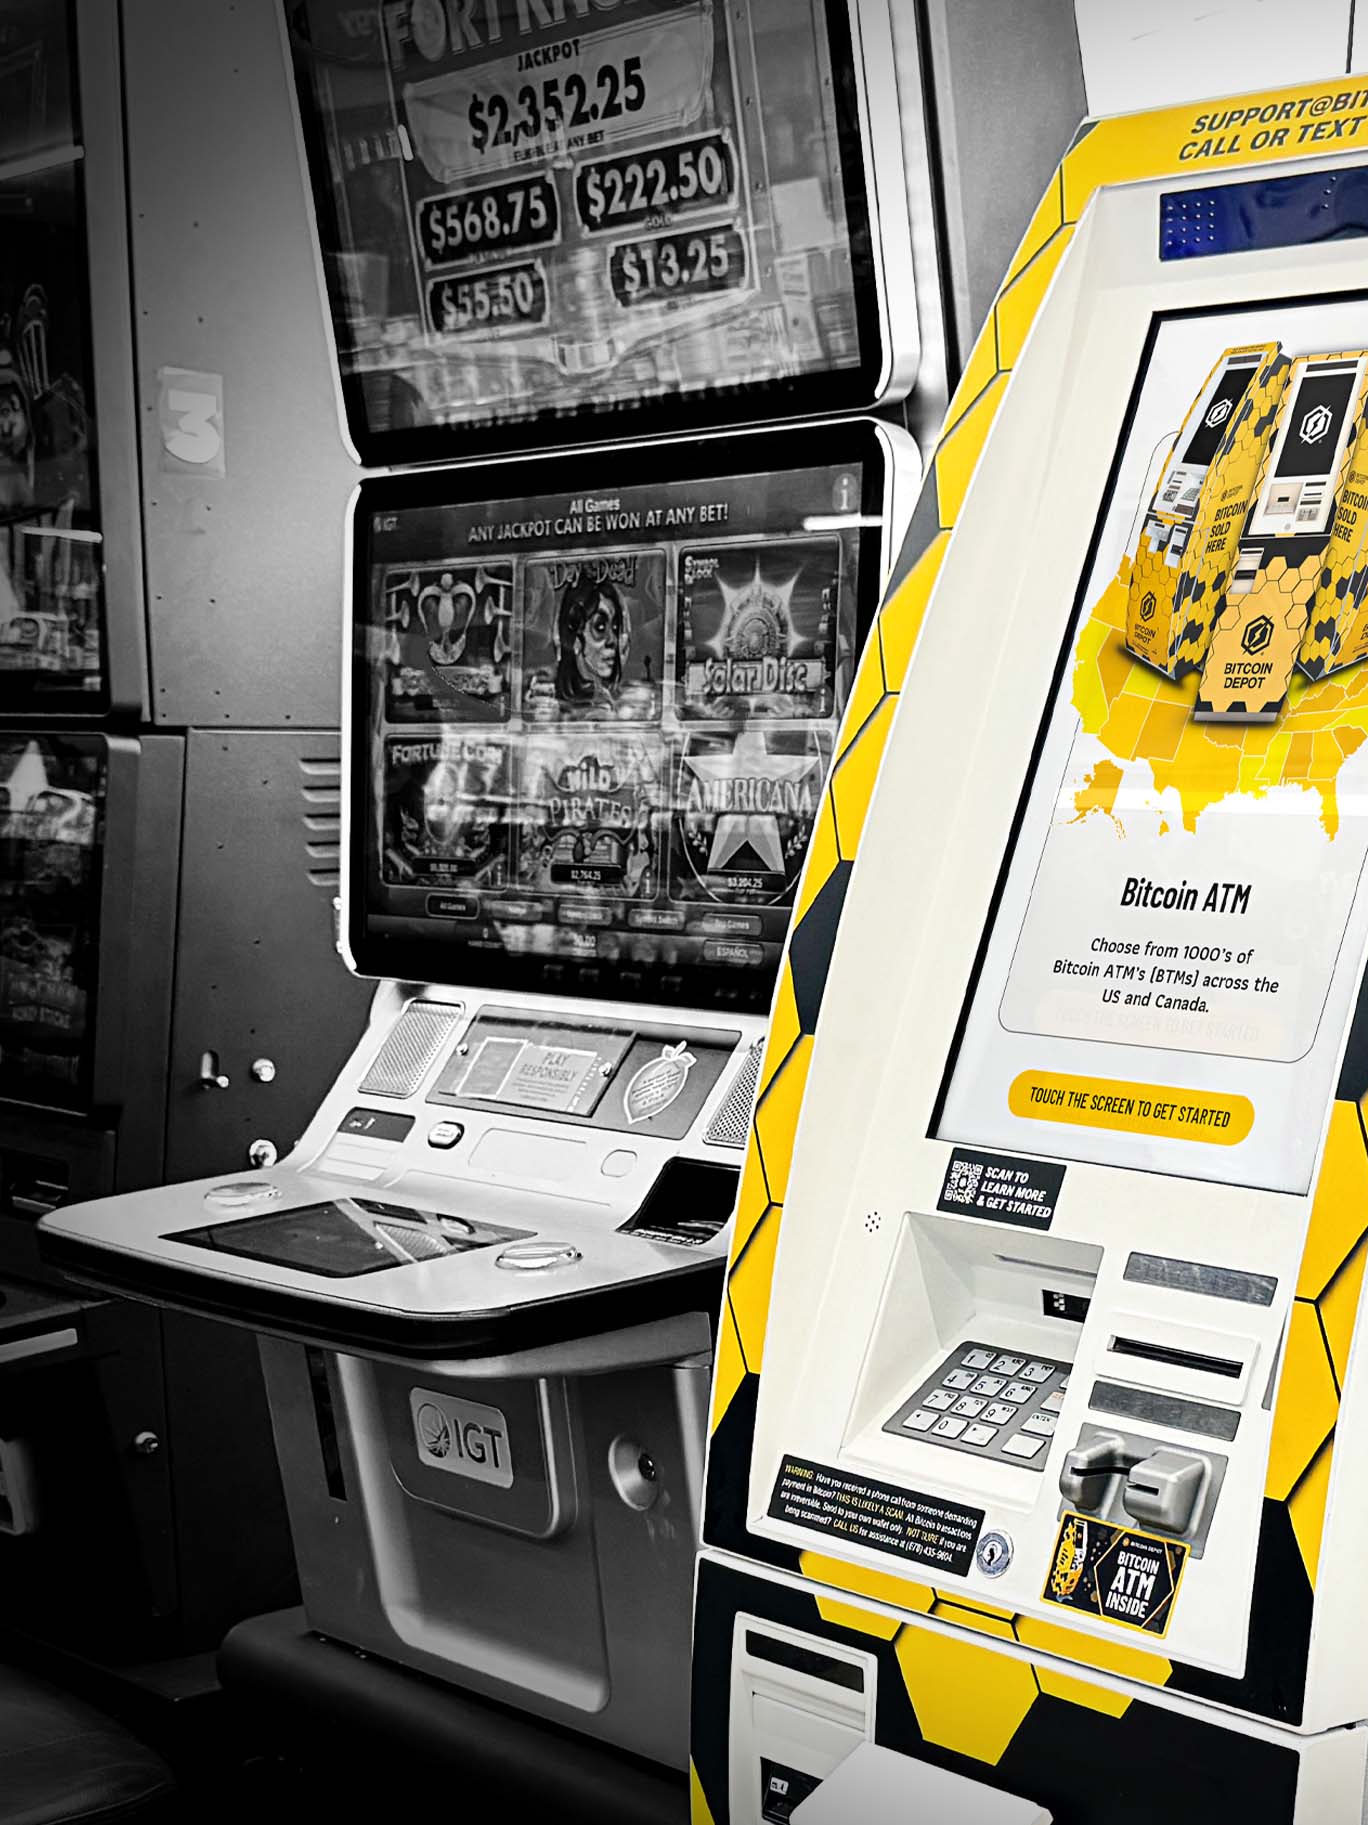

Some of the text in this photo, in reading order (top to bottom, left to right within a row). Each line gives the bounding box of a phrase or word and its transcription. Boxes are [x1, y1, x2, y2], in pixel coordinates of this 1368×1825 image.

[517, 39, 580, 72] JACKPOT
[469, 56, 645, 154] $2,352.25
[1178, 130, 1246, 163] CALL
[1249, 124, 1294, 152] OR
[1296, 117, 1367, 145] TEXT
[586, 145, 722, 222] $222.50
[429, 186, 547, 255] $568.75
[622, 234, 729, 301] $13.25
[441, 271, 533, 332] $55.50
[570, 499, 584, 514] All
[1214, 500, 1248, 521] BITCOIN
[1338, 506, 1357, 525] SOLD
[468, 504, 728, 544] ANY JACKPOT CAN BE WON AT ANY BET!
[1210, 522, 1230, 538] SOLD
[1334, 522, 1353, 543] HERE
[1205, 538, 1227, 553] HERE
[703, 657, 808, 695] Solar Disc
[1224, 662, 1273, 674] BITCOIN
[1224, 677, 1266, 689] DEPOT
[687, 778, 812, 815] AMERICANA
[1120, 877, 1252, 914] Bitcoin ATM
[1090, 937, 1254, 964] Choose from 1000's of
[1053, 960, 1100, 978] Bitcoin
[1104, 963, 1146, 983] ATM's
[1202, 976, 1249, 991] across
[1254, 976, 1279, 994] the
[1101, 989, 1210, 1014] US and Canada.
[1030, 1086, 1231, 1128] TOUCH THE SCREEN TO GET STARTED
[985, 1166, 1029, 1184] SCAN TO
[981, 1179, 1046, 1202] LEARN MORE
[977, 1194, 1052, 1219] & GET STARTED
[967, 1355, 976, 1363] 1
[994, 1361, 1005, 1370] 2
[947, 1374, 957, 1383] 4
[1024, 1368, 1035, 1377] 3
[975, 1381, 987, 1390] 5
[1005, 1388, 1015, 1398] 6
[928, 1394, 939, 1404] 7
[956, 1402, 967, 1411] 8
[938, 1420, 948, 1430] 0
[986, 1409, 996, 1418] 9
[454, 1418, 504, 1469] IGT
[781, 1476, 806, 1492] payment
[805, 1483, 812, 1492] in
[812, 1485, 836, 1499] Bitcoin?
[835, 1492, 851, 1504] THIS
[850, 1496, 858, 1506] IS
[857, 1498, 880, 1512] LIKELY
[879, 1504, 885, 1514] A
[904, 1512, 915, 1523] All
[914, 1515, 936, 1529] Bitcoin
[935, 1521, 973, 1540] transactions
[815, 1472, 831, 1484] Have
[830, 1478, 841, 1489] you
[841, 1480, 866, 1495] received
[870, 1488, 890, 1503] phone
[889, 1493, 901, 1505] call
[901, 1497, 917, 1509] from
[916, 1503, 943, 1517] someone
[943, 1509, 978, 1528] demanding
[783, 1503, 800, 1517] being
[832, 1518, 848, 1530] CALL
[848, 1523, 859, 1534] US
[858, 1526, 868, 1537] for
[867, 1528, 899, 1546] assistance
[898, 1538, 905, 1548] at
[904, 1540, 923, 1555] (678)
[821, 1501, 955, 1551] Send to your own wallet NOT SURE you
[1130, 1541, 1163, 1555] BITCOIN DEPOT
[1117, 1550, 1160, 1573] BITCOIN
[1110, 1569, 1156, 1600] ATM
[1105, 1591, 1149, 1618] INSIDE
